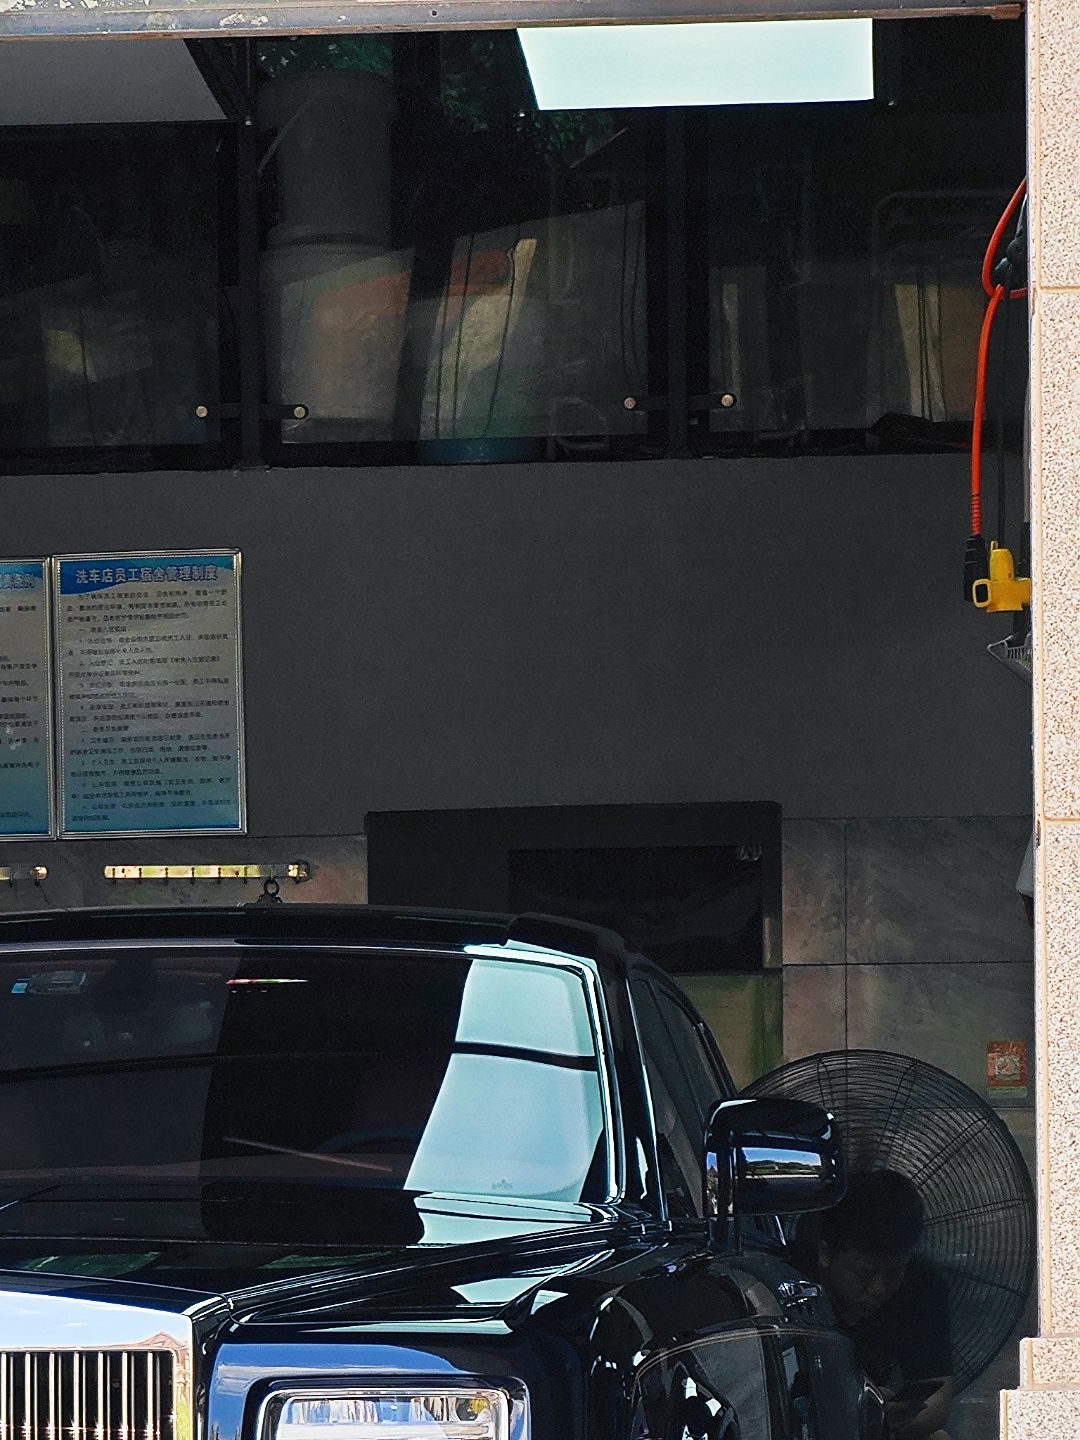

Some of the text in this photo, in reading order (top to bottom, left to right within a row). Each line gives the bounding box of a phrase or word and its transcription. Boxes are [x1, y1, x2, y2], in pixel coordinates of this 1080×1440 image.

[75, 564, 218, 584] 洗车店员工宿舍管理制度
